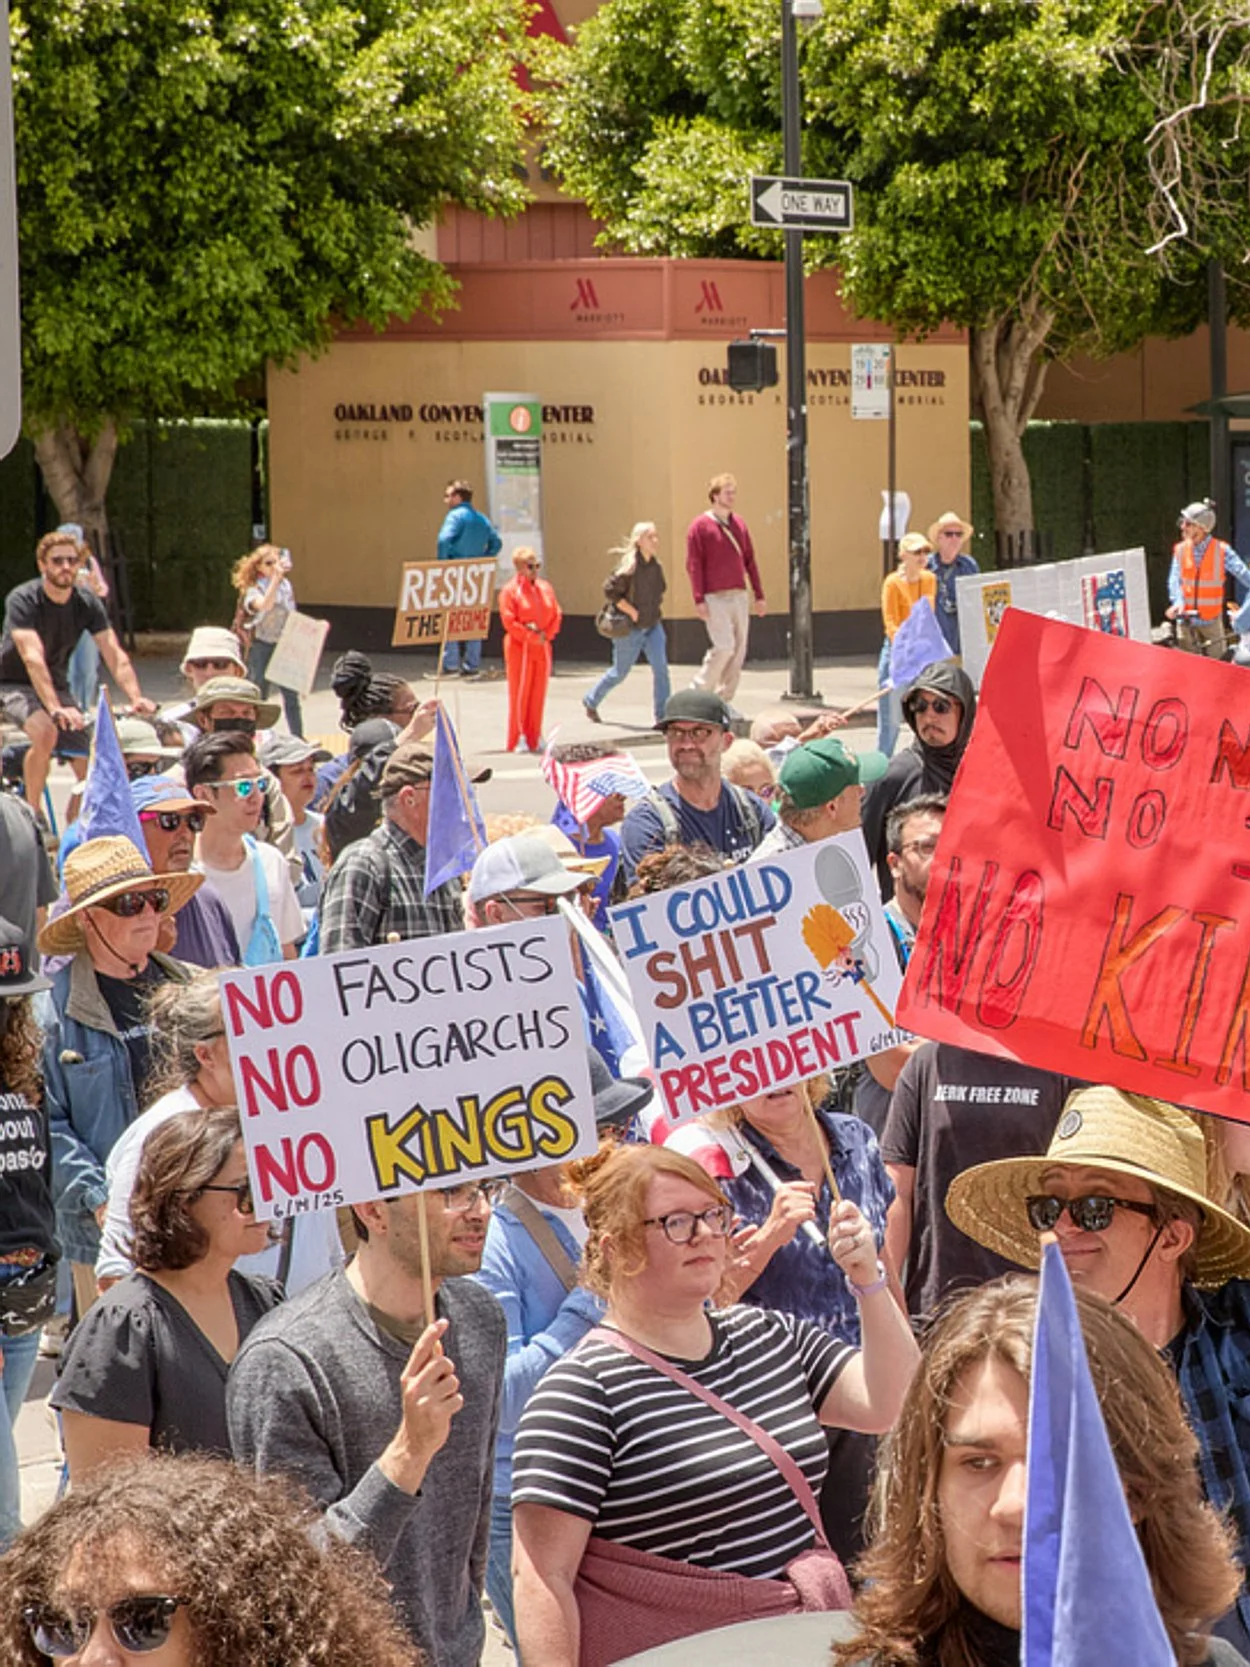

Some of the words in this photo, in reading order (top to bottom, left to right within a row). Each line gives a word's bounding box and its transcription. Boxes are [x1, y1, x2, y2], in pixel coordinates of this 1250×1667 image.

[782, 193, 808, 212] ONE
[813, 195, 840, 212] WAY
[334, 404, 414, 423] OAKLAND
[419, 405, 484, 424] CONVEN
[541, 405, 595, 424] ENTER
[400, 563, 496, 612] RESIST
[405, 613, 442, 638] THE
[448, 607, 488, 633] REGIME
[1064, 677, 1190, 772] NO
[1047, 764, 1168, 850] NO
[611, 903, 659, 960] I
[667, 864, 793, 938] COULD
[918, 856, 1047, 1031] NO
[225, 970, 304, 1037] NO
[333, 936, 554, 1017] FASCISTS
[646, 916, 778, 1010] SHIT
[239, 1044, 322, 1118] NO
[342, 1005, 570, 1085] OLIGARCHS
[654, 1021, 687, 1070] A
[688, 970, 832, 1053] BETTER
[659, 1010, 862, 1120] PRESIDENT
[254, 1132, 337, 1202] NO
[364, 1074, 580, 1192] KINGS
[934, 1084, 968, 1102] JERK
[969, 1086, 1001, 1104] FREE
[1003, 1087, 1040, 1106] ZONE
